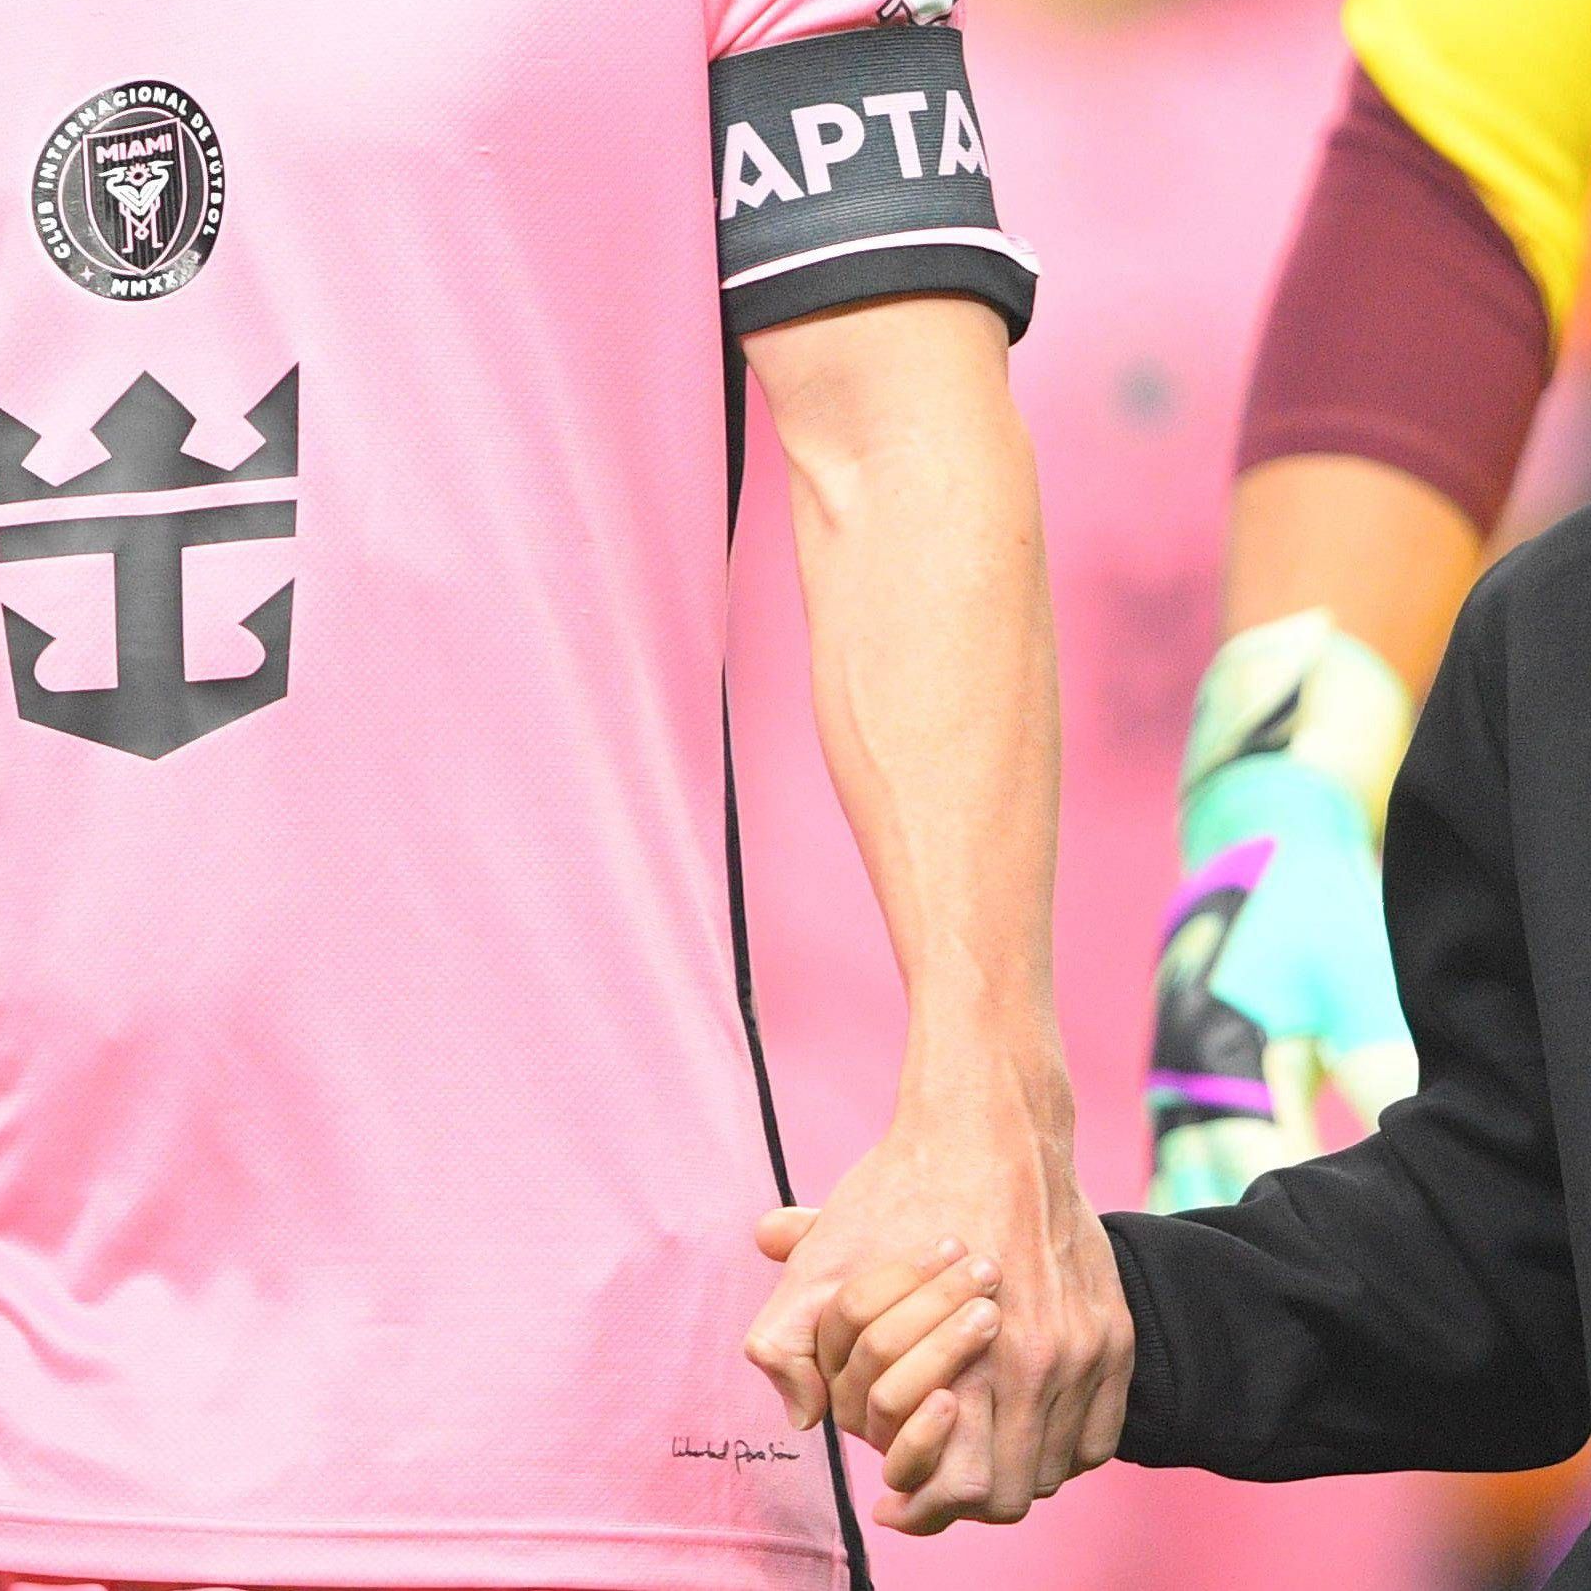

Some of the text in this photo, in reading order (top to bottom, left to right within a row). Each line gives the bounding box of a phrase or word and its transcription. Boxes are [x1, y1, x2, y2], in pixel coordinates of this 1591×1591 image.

[37, 86, 188, 190] INTERNACIONAL
[190, 113, 212, 141] DE
[95, 133, 173, 164] MIAMI
[37, 200, 71, 260] CLUB
[110, 270, 178, 297] MMXX
